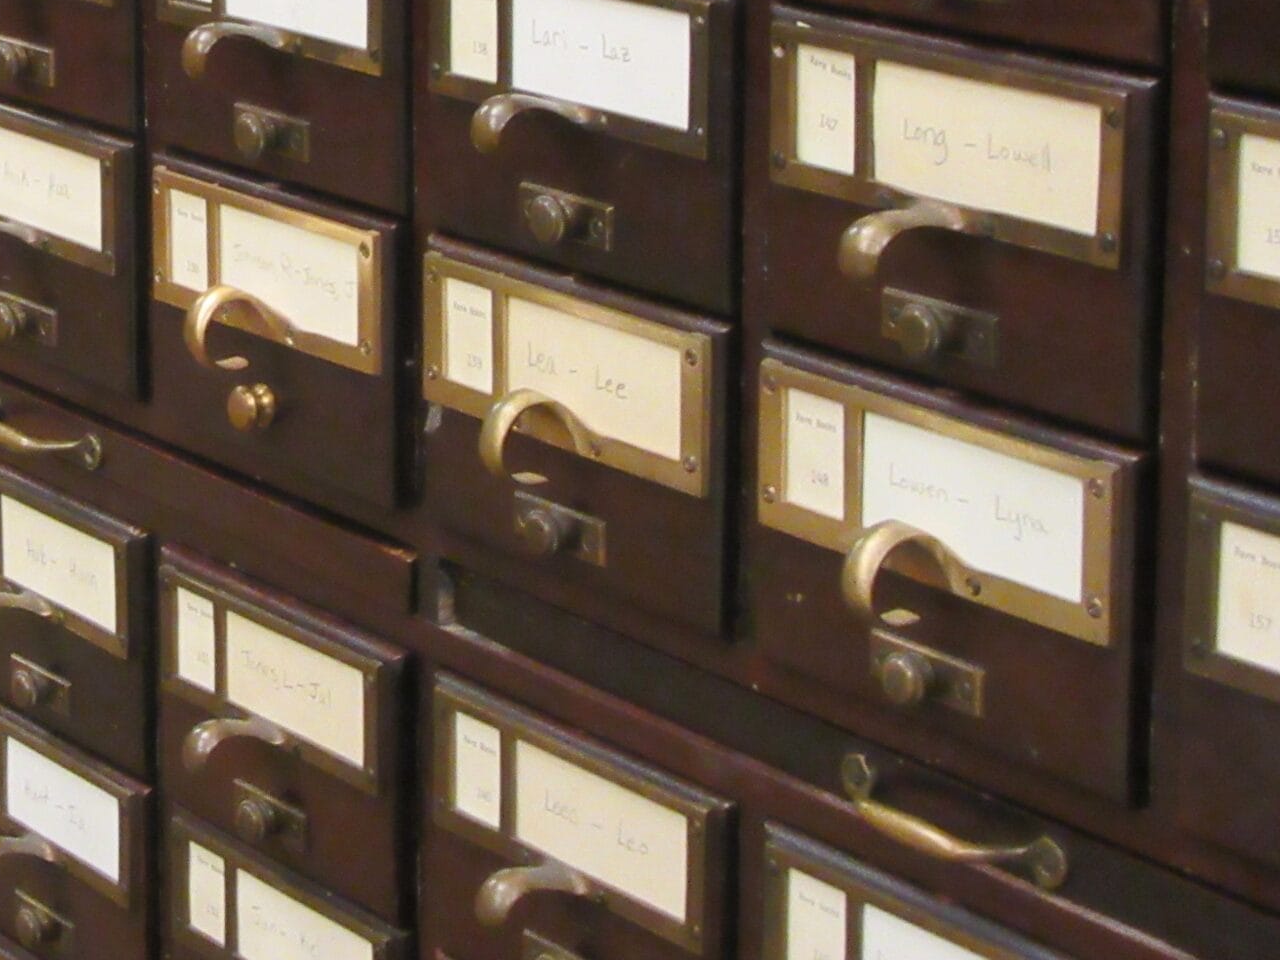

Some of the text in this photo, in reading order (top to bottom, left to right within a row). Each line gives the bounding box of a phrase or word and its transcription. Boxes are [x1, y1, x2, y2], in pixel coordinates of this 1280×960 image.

[602, 32, 632, 63] Laz
[903, 116, 949, 167] Long
[595, 363, 628, 401] Lee
